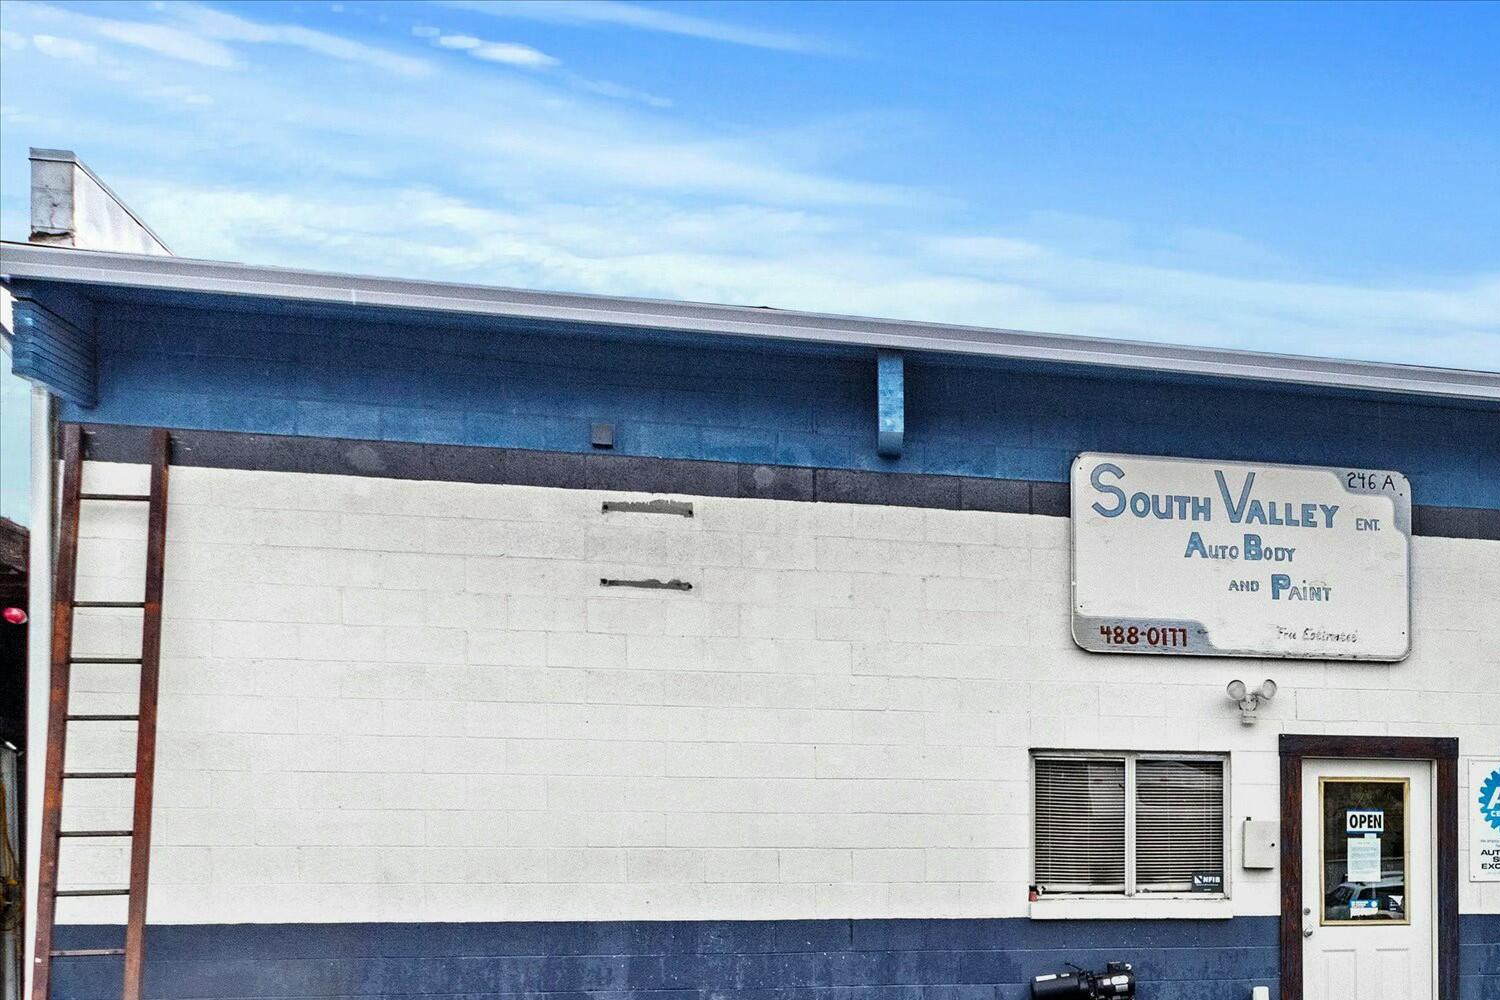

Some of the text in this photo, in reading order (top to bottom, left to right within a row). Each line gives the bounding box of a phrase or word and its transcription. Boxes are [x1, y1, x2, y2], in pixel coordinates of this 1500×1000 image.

[1347, 472, 1396, 491] 246 A
[1090, 463, 1381, 531] SOUTH VALLEY ENT.
[1184, 531, 1297, 562] AUTO BODY
[1228, 580, 1260, 592] AND
[1100, 625, 1187, 647] 488-0177
[1349, 814, 1382, 829] OPEN
